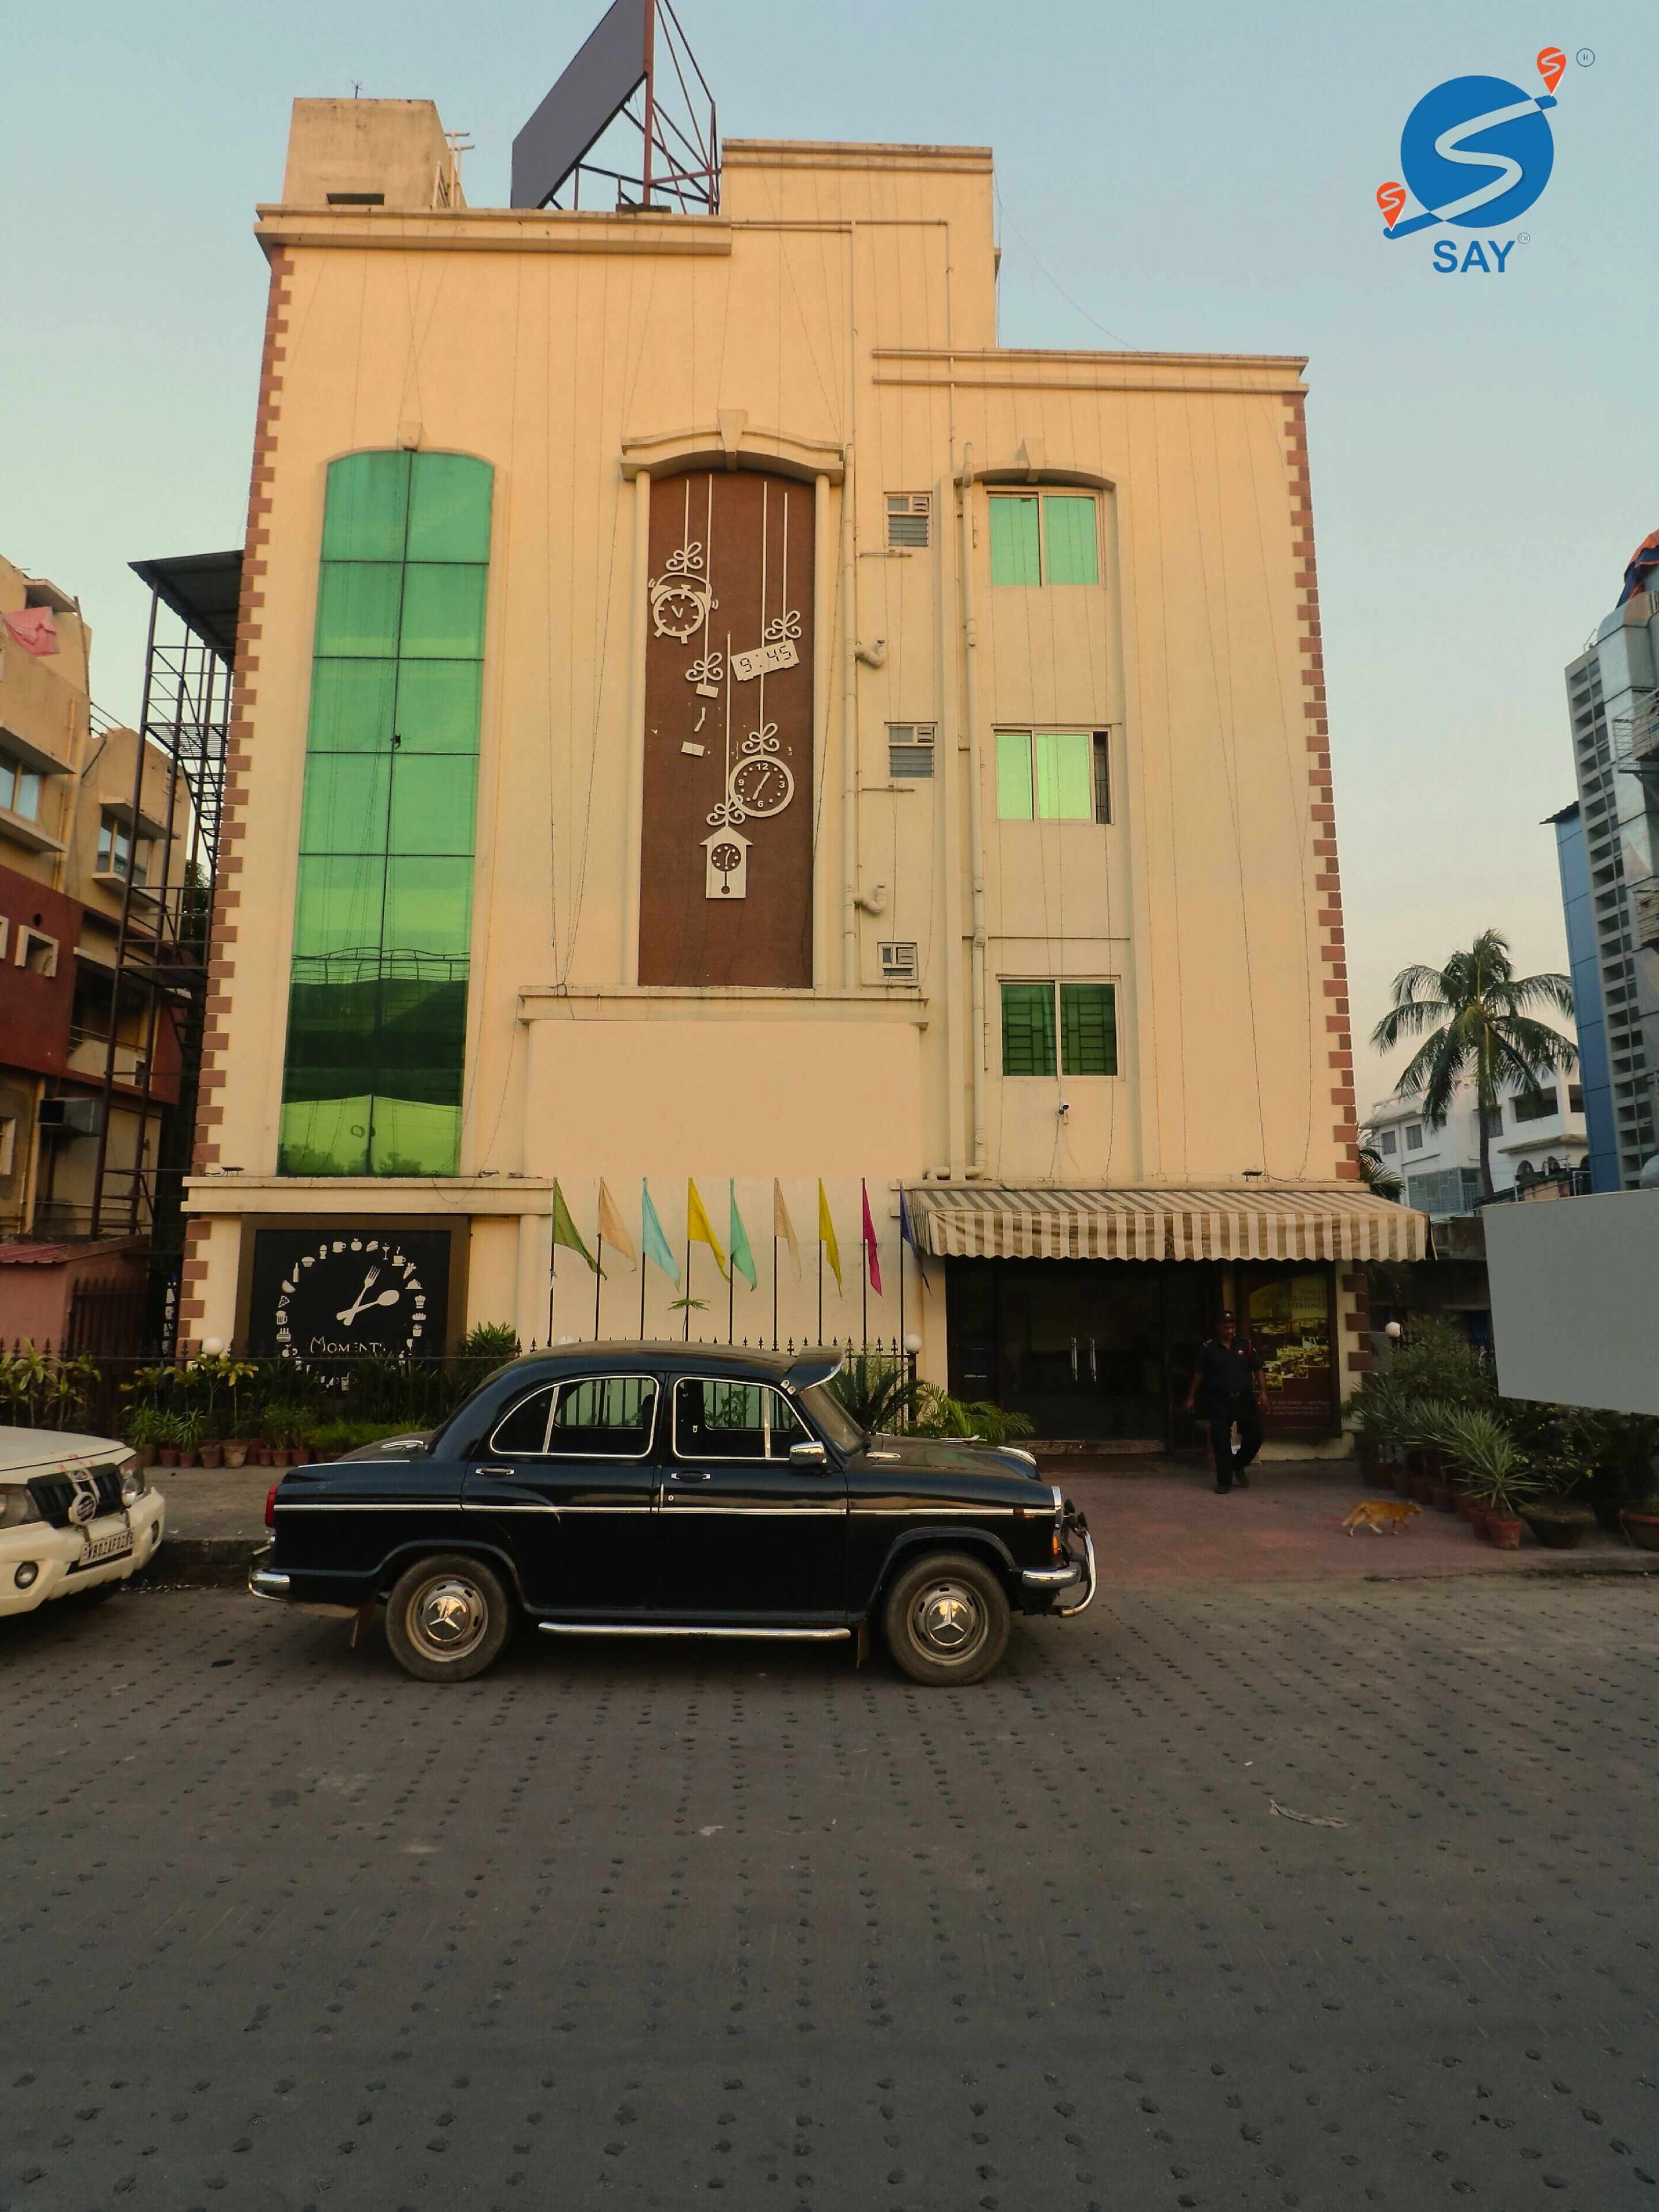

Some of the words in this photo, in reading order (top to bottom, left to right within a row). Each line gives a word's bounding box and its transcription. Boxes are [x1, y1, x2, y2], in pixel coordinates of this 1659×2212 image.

[756, 763, 769, 771] 12
[738, 778, 745, 786] 9
[778, 781, 785, 789] 3
